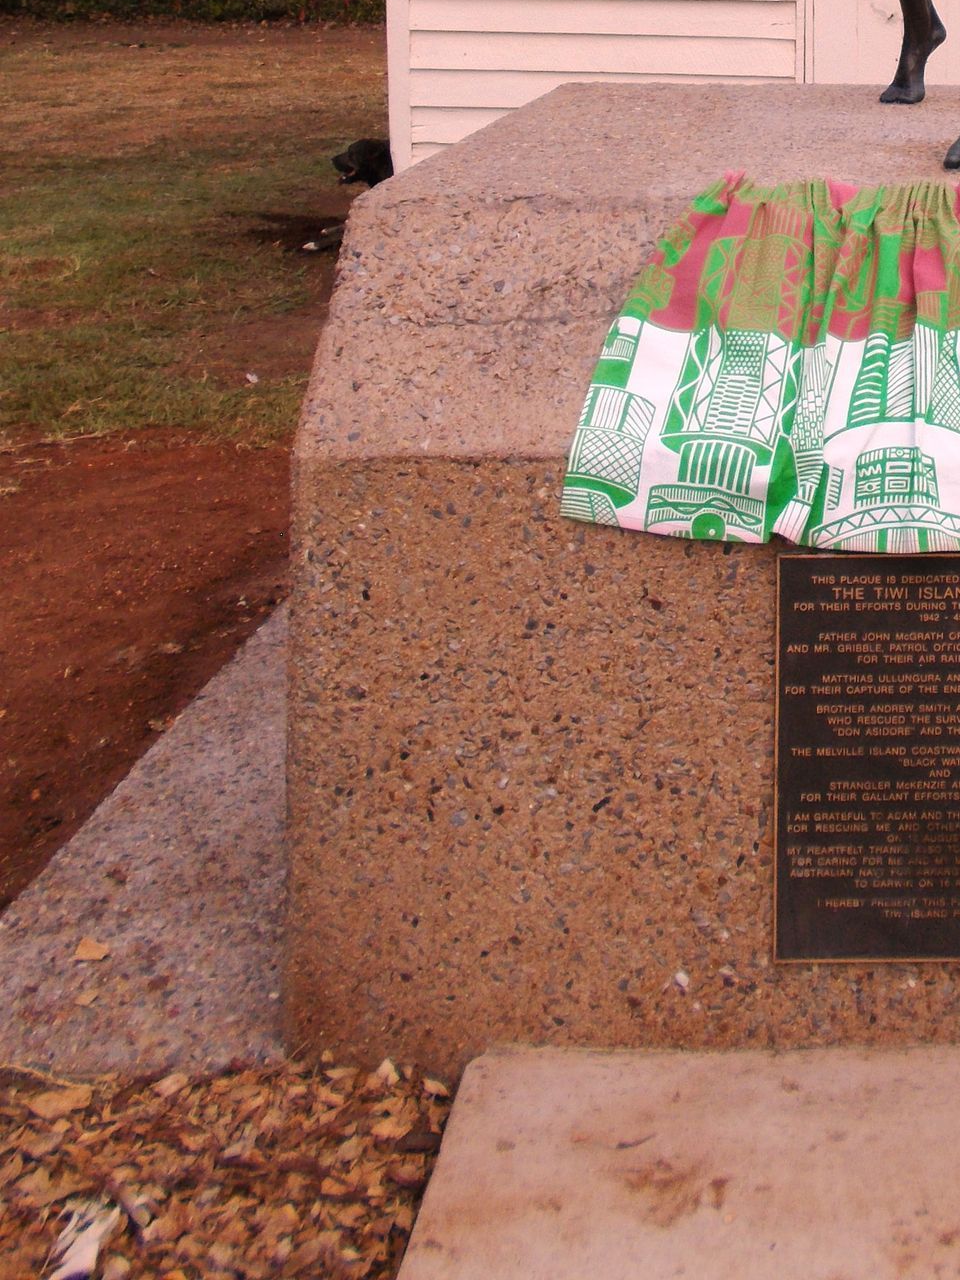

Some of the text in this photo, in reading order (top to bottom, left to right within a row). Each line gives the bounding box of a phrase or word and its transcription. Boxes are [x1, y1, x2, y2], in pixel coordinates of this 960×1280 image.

[812, 575, 835, 585] THIS
[840, 575, 881, 585] PLAQUE
[886, 575, 895, 584] IS
[901, 575, 960, 584] DEDICATED
[832, 587, 864, 600] THE
[874, 587, 909, 600] TIWI
[794, 602, 815, 612] FOR
[820, 602, 850, 611] THEIR
[856, 601, 901, 611] EFFORTS
[906, 601, 946, 611] DURING
[919, 614, 940, 622] 1942
[819, 632, 857, 642] FATHER
[862, 632, 890, 641] JOHN
[895, 632, 944, 641] McGRATH
[787, 644, 809, 654] AND
[889, 643, 928, 653] PATROL
[857, 654, 877, 664] FOR
[883, 654, 913, 664] THEIR
[919, 654, 936, 663] AIR
[822, 674, 873, 683] MATTHIAS
[785, 685, 805, 695] FOR
[811, 685, 841, 695] THEIR
[846, 685, 894, 694] CAPTURE
[899, 685, 913, 694] OF
[919, 684, 939, 694] THE
[816, 705, 865, 714] BROTHER
[870, 704, 914, 714] ANDREW
[919, 704, 951, 713] SMITH
[828, 716, 852, 725] WHO
[857, 716, 906, 725] RESCUED
[911, 715, 931, 725] THE
[920, 726, 943, 736] AND
[791, 747, 811, 756] THE
[816, 747, 864, 756] MELVILLE
[869, 747, 906, 756] ISLAND
[929, 769, 951, 778] AND
[829, 781, 891, 790] STRANGLER
[896, 781, 946, 790] McKENZIE
[801, 793, 821, 802] FOR
[826, 793, 857, 802] THEIR
[862, 792, 908, 802] GALLANT
[914, 792, 960, 801] EFFORTS
[794, 812, 810, 821] AM
[813, 812, 866, 821] GRATEFUL
[920, 811, 942, 820] AND
[787, 824, 808, 833] FOR
[815, 824, 869, 832] RESCUING
[876, 823, 890, 832] ME
[898, 823, 920, 832] AND
[807, 846, 863, 855] HEARTFELT
[791, 858, 812, 866] FOR
[862, 857, 883, 866] FOR
[790, 869, 854, 878] AUSTRALIAN
[854, 880, 868, 889] TO
[918, 879, 934, 888] ON
